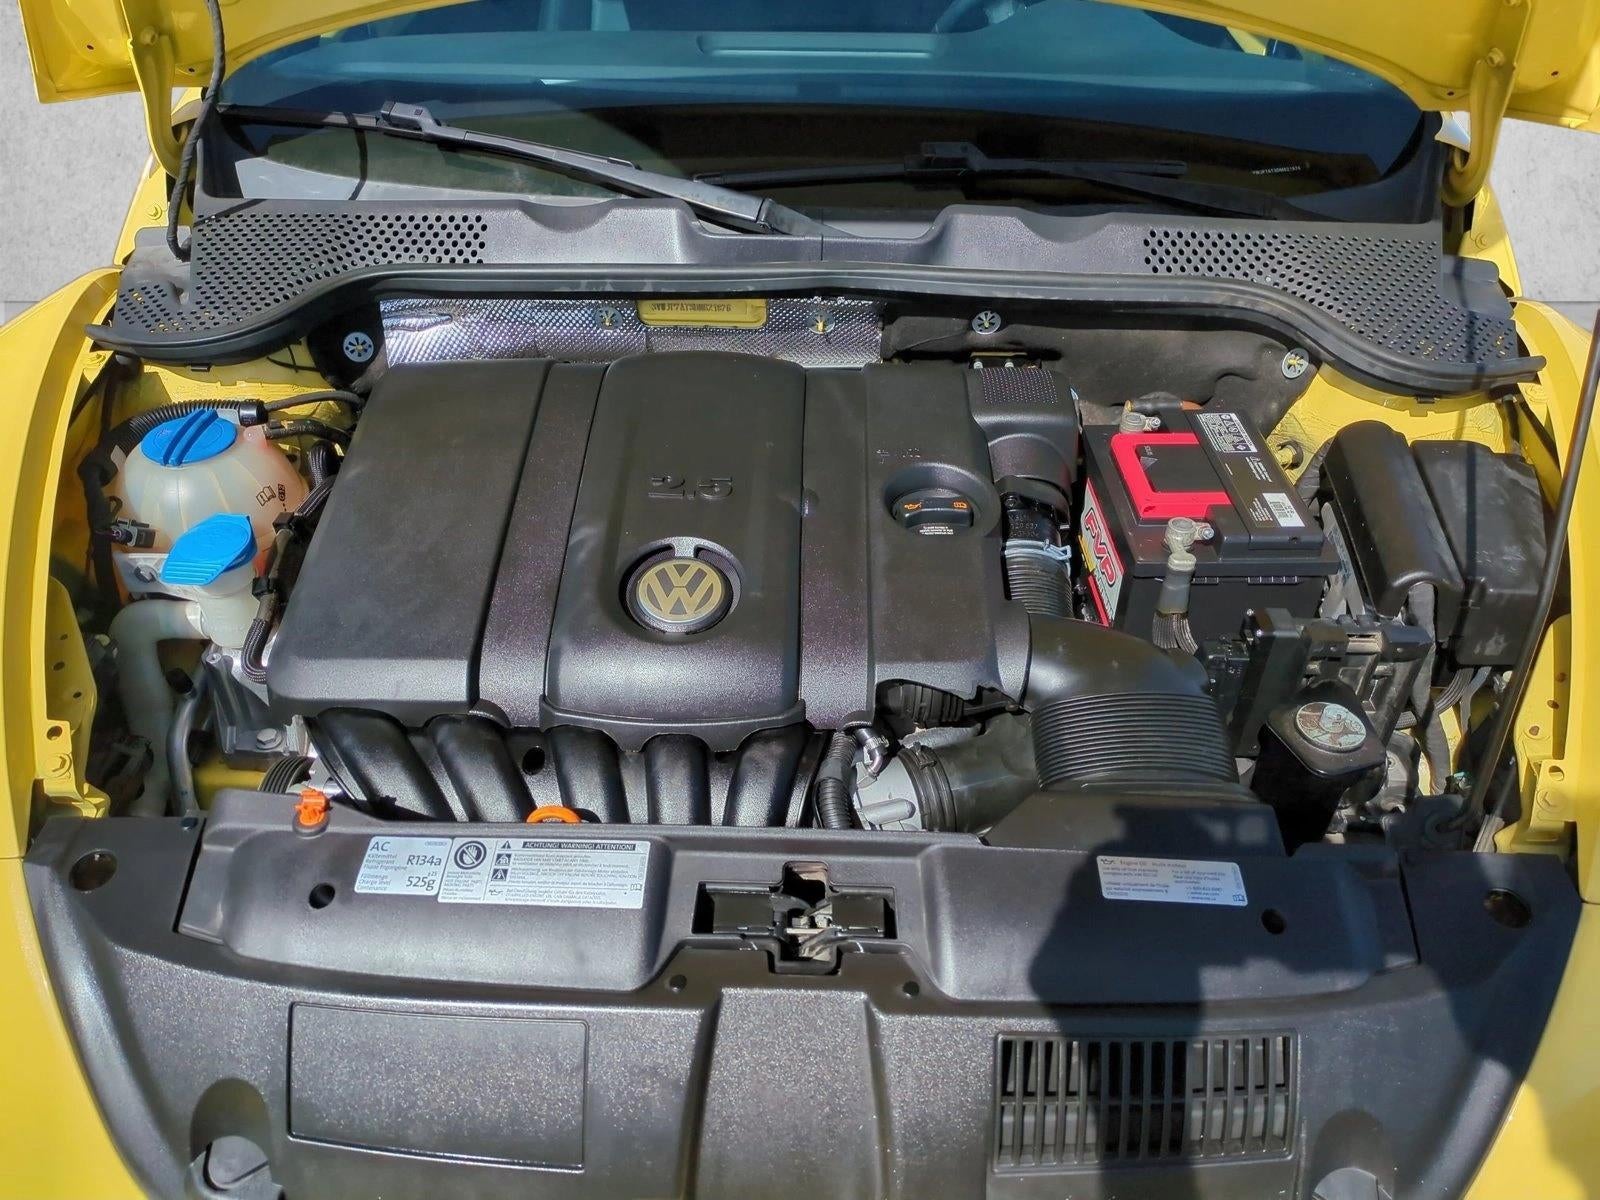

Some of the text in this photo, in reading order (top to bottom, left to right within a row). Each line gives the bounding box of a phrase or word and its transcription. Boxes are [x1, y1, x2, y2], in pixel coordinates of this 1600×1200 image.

[648, 474, 734, 501] 2.5
[1083, 507, 1116, 587] FVP
[637, 561, 722, 622] VW
[370, 841, 390, 852] AC
[595, 843, 635, 851] ATTENTION!
[406, 854, 442, 866] R134a
[406, 876, 436, 891] 525g
